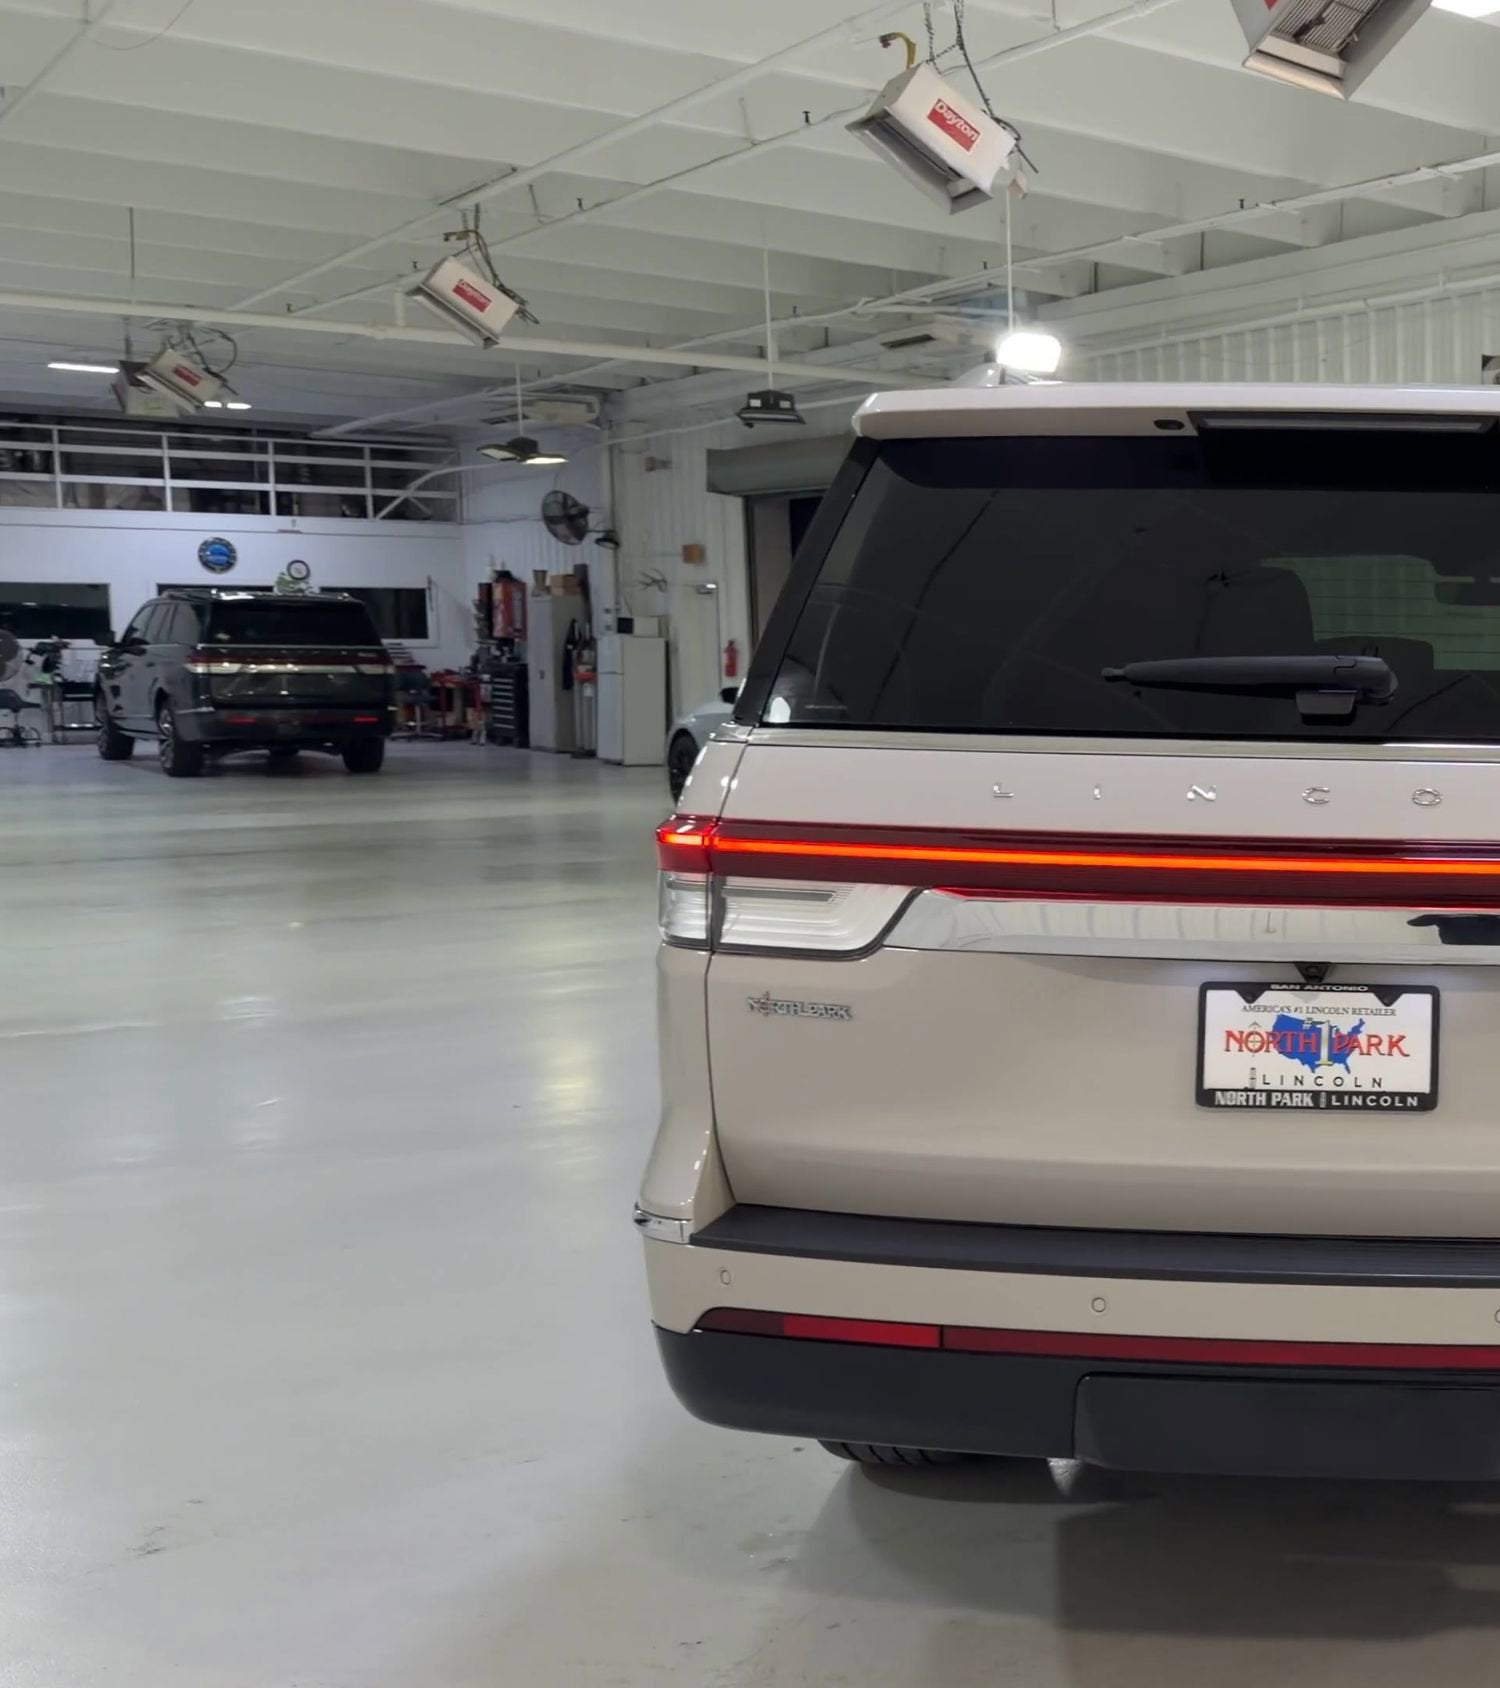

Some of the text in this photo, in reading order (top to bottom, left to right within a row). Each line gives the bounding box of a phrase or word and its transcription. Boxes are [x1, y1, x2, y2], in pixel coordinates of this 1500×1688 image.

[934, 101, 978, 141] Dayton
[1304, 984, 1369, 992] ANTONIO
[1242, 1005, 1292, 1014] AMERICA'S
[1305, 1007, 1350, 1016] LINCOLN
[1351, 1007, 1397, 1017] RETAILER
[1224, 1030, 1411, 1057] NORTH PARK
[1262, 1074, 1383, 1088] LINCOLN
[1215, 1090, 1418, 1107] NORTH PARK LINCOLN
